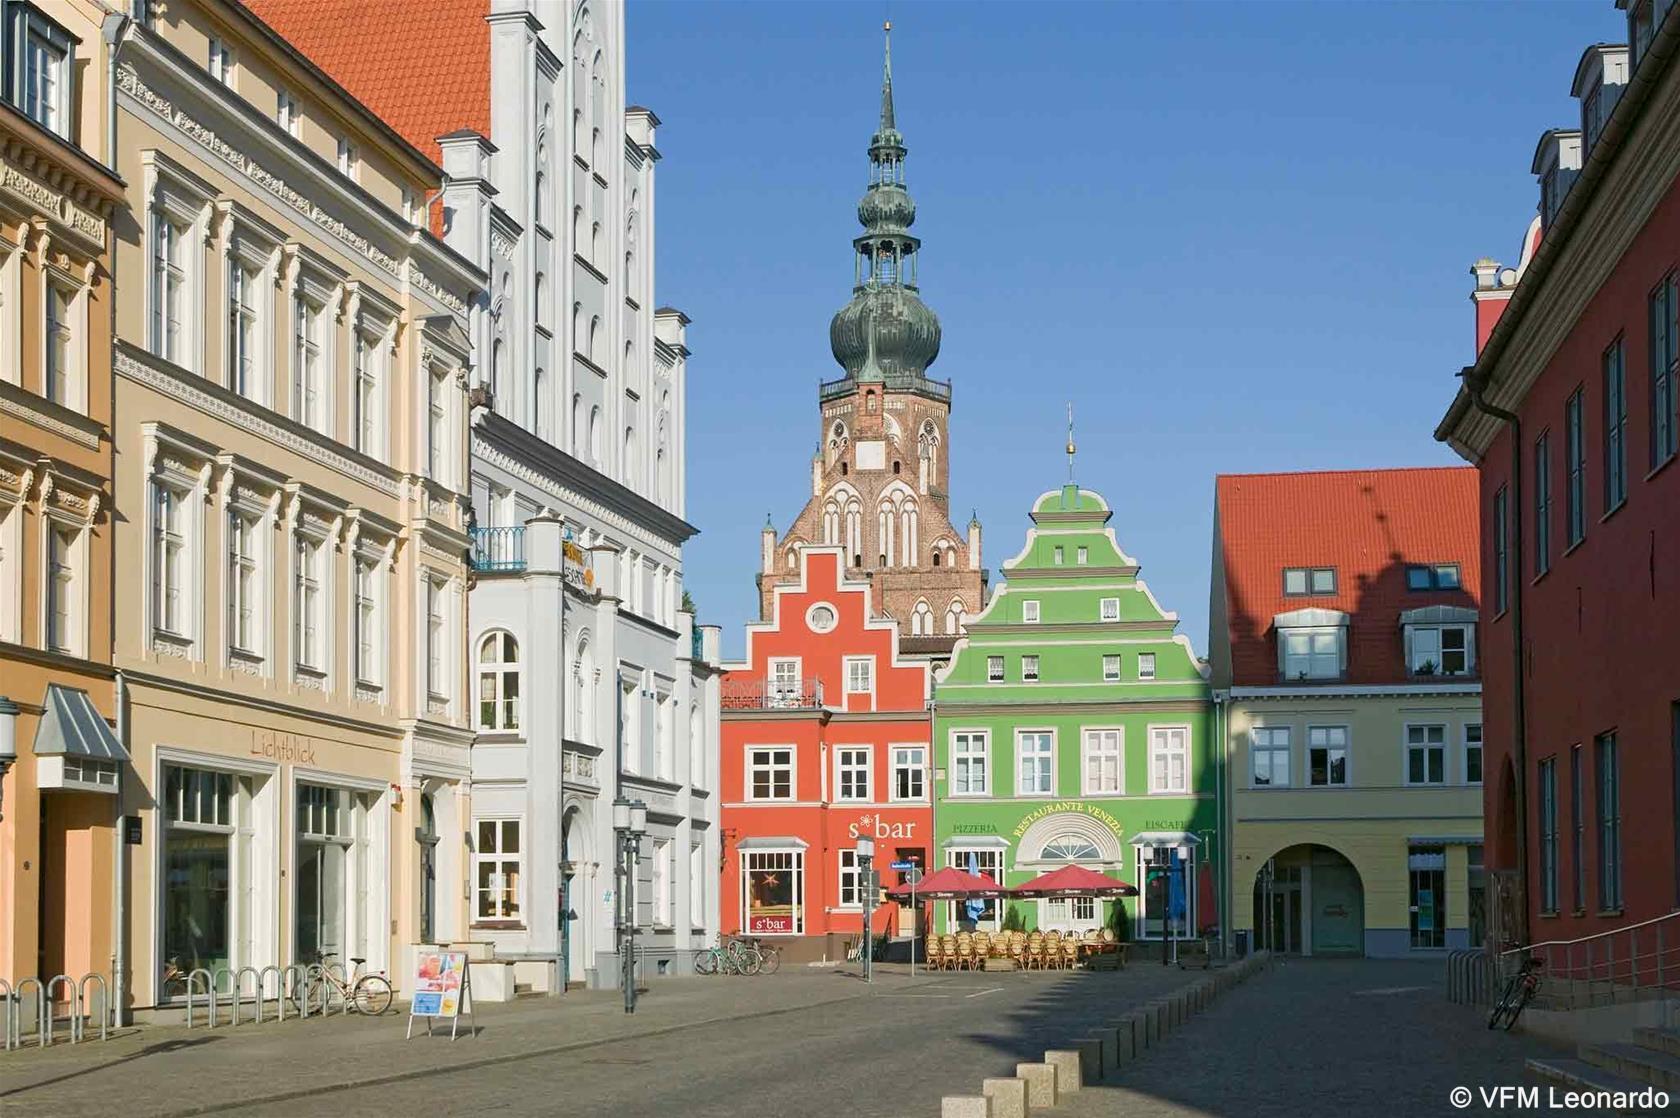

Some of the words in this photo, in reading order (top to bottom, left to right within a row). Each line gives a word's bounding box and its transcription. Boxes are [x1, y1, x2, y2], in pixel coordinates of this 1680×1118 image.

[250, 730, 316, 765] Lichtblick
[952, 824, 998, 833] PIZZERIA
[1014, 802, 1084, 837] RESTAURANTE
[1087, 805, 1124, 837] VENEZIA
